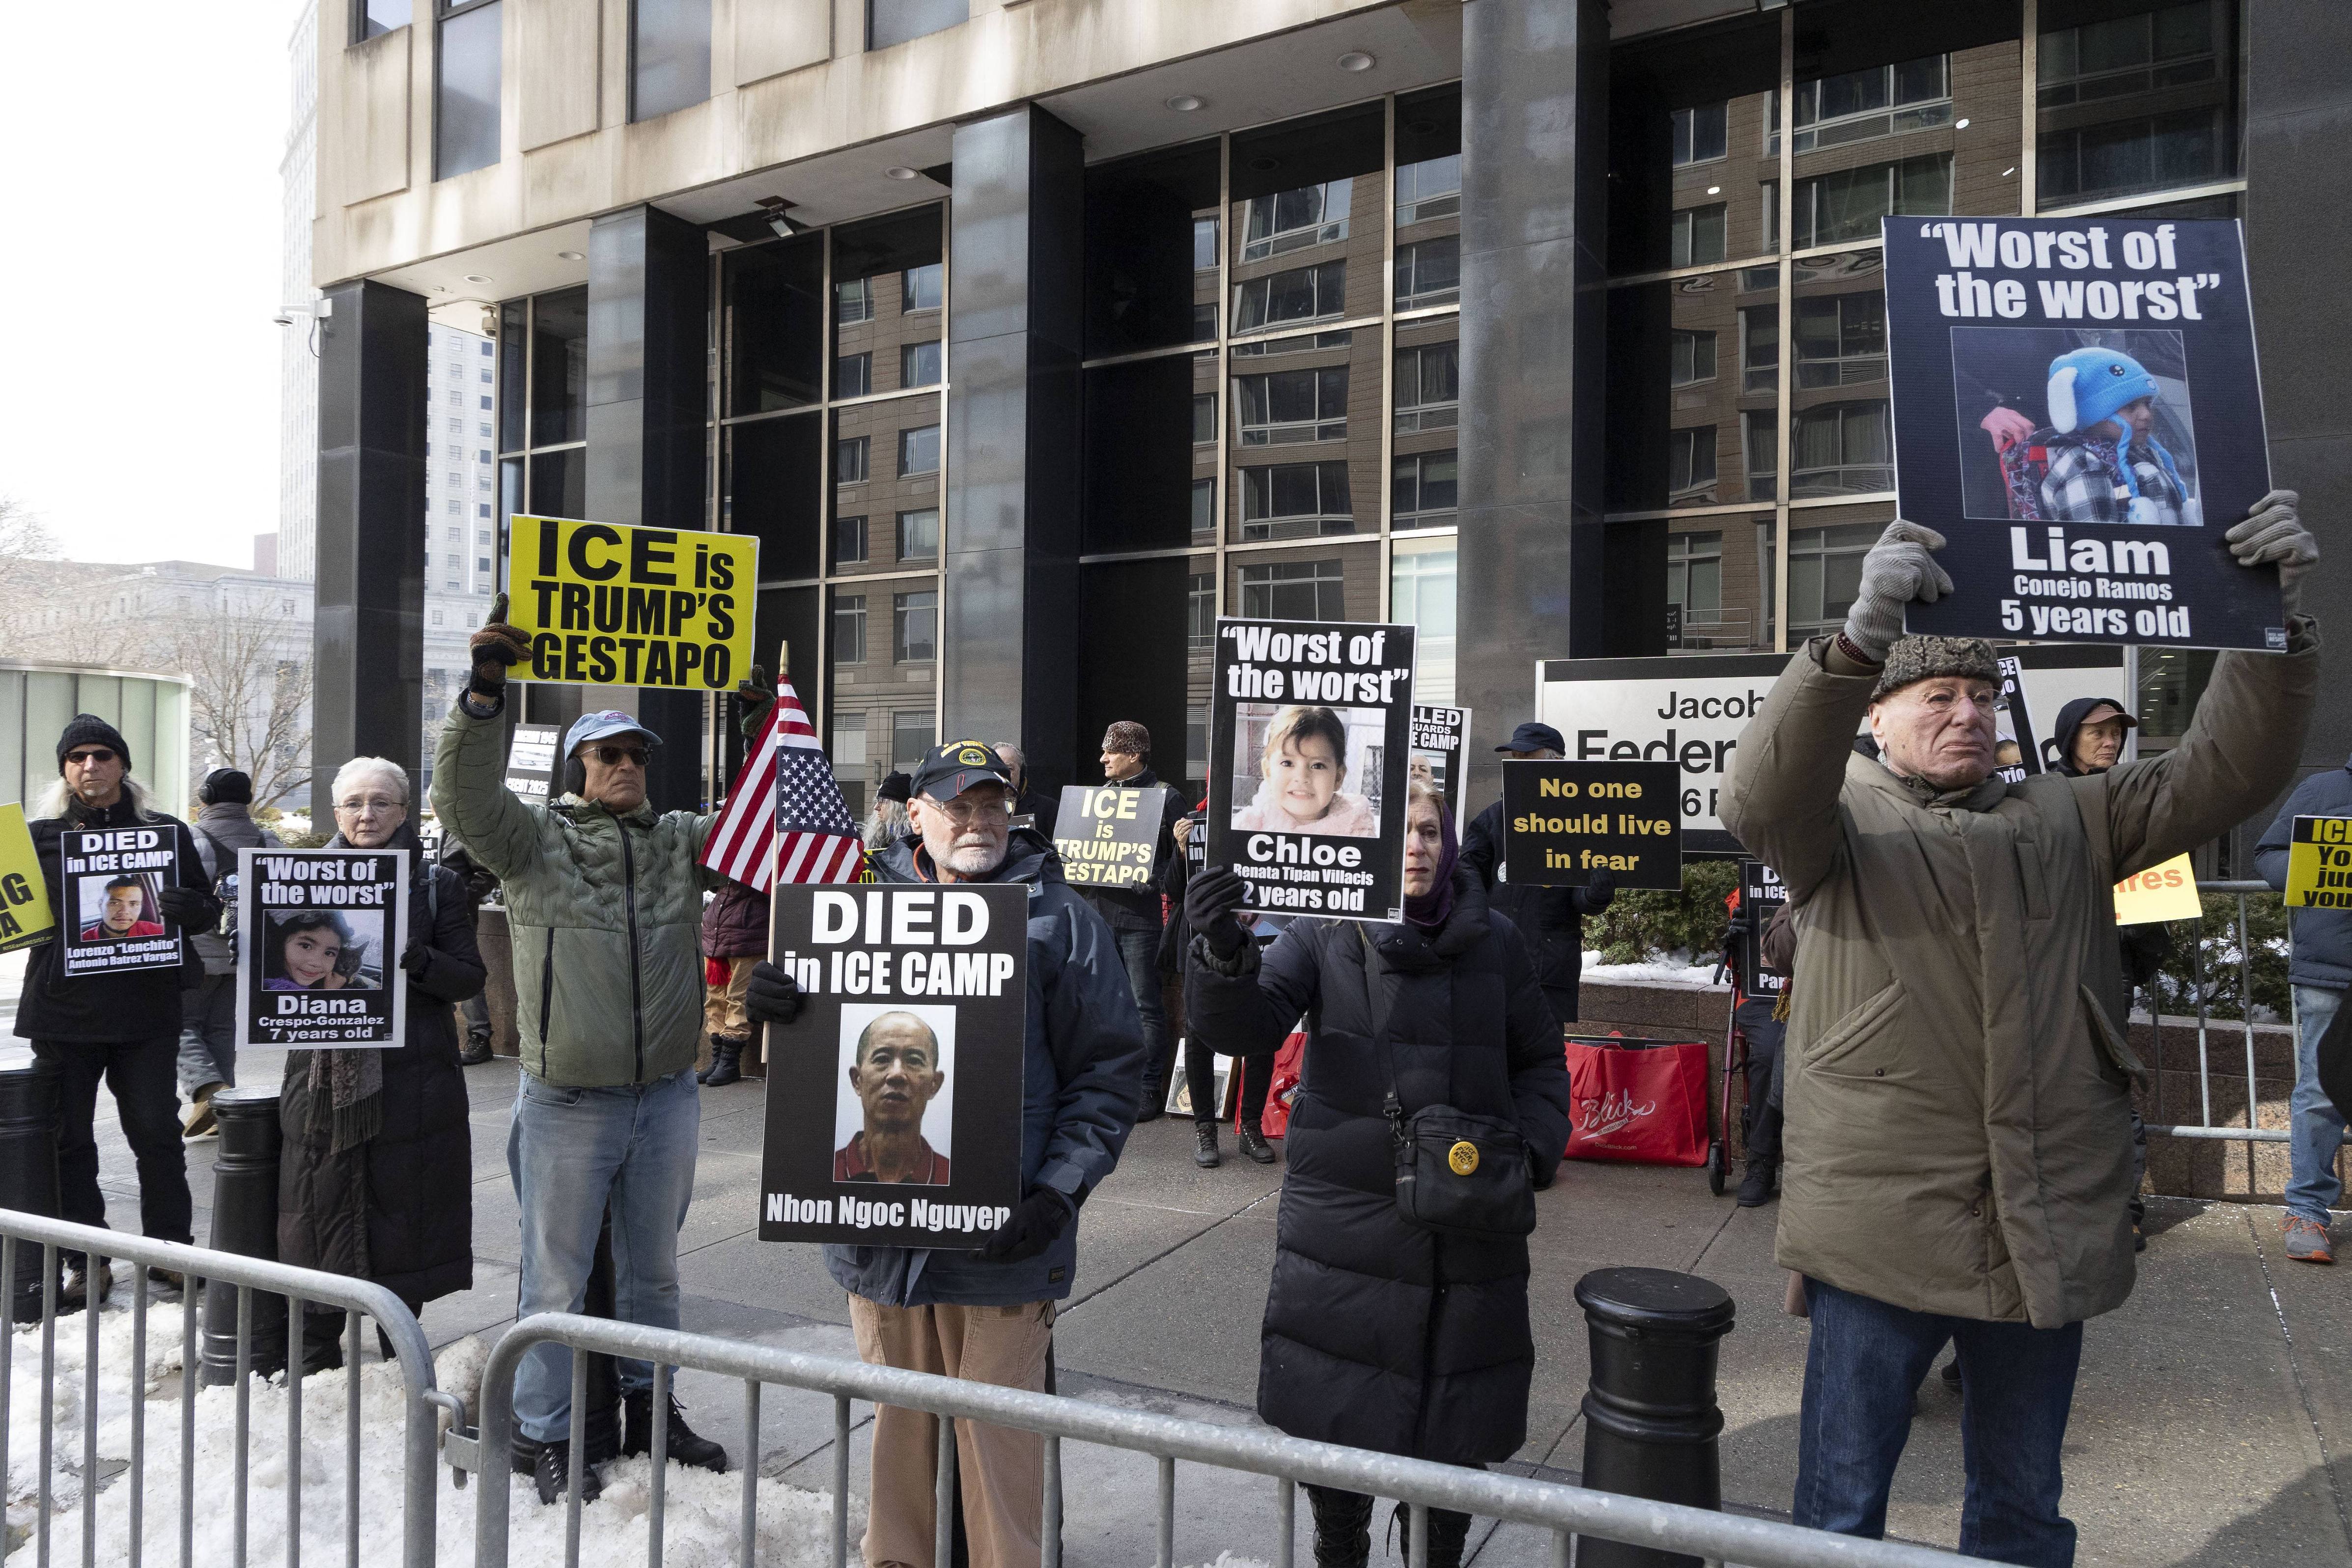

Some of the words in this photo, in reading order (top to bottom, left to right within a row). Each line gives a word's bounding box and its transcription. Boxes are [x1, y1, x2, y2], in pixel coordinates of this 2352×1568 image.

[1921, 223, 2112, 270] “Worst
[2122, 224, 2177, 270] of
[1935, 272, 2027, 318] the
[2038, 274, 2220, 320] worst”
[538, 520, 678, 586] ICE
[694, 544, 734, 590] is
[2011, 527, 2170, 575] Liam
[2014, 575, 2092, 598] Conejo
[2097, 577, 2172, 601] Ramos
[531, 580, 735, 640] TRUMP’S
[2001, 599, 2023, 631] 5
[2032, 605, 2128, 635] years
[2136, 605, 2190, 637] old
[1222, 626, 1342, 664] “Worst
[1349, 630, 1385, 666] of
[532, 632, 730, 688] GESTAPO
[1998, 660, 2016, 676] CE
[1228, 663, 1284, 699] the
[1292, 668, 1408, 703] worst”
[1657, 690, 1765, 719] Jacob
[1413, 707, 1460, 726] LED
[1421, 732, 1459, 750] CAMP
[1540, 778, 1578, 798] No
[1588, 781, 1642, 799] one
[1081, 789, 1140, 819] ICE
[1681, 788, 1701, 817] 6
[1095, 820, 1114, 839] is
[1513, 813, 1608, 834] should
[1619, 814, 1671, 836] live
[82, 831, 159, 852] DIED
[1055, 839, 1151, 864] TRUMP’S
[1189, 845, 1203, 860] in
[1247, 834, 1361, 867] Chloe
[67, 857, 85, 873] in
[89, 854, 118, 871] ICE
[122, 851, 174, 869] CAMP
[1546, 849, 1570, 868] in
[1581, 849, 1640, 871] fear
[2318, 846, 2352, 867] Yo
[256, 857, 346, 880] “Worst
[352, 858, 377, 881] of
[1062, 862, 1148, 884] ESTAPO
[1233, 864, 1279, 880] Renata
[1282, 867, 1319, 883] Tipan
[1322, 869, 1373, 886] Villacis
[261, 881, 304, 904] the
[310, 882, 394, 904] worst”
[1242, 881, 1254, 904] 2
[1259, 886, 1322, 908] years
[1327, 887, 1364, 911] old
[1749, 885, 1762, 898] in
[1765, 886, 1786, 899] ICE
[812, 891, 990, 945] DIED
[67, 945, 114, 958] Lorenzo
[116, 939, 178, 953] “Lenchito”
[69, 957, 108, 969] Antonio
[110, 954, 141, 965] Batrez
[142, 951, 178, 963] Vargas
[784, 951, 820, 993] in
[831, 951, 891, 994] ICE
[900, 952, 1014, 996] CAMP
[278, 995, 366, 1014] Diana
[258, 1016, 384, 1028] Crespo-Gonzalez
[270, 1029, 281, 1040] 7
[287, 1029, 338, 1042] years
[345, 1027, 372, 1038] old
[1576, 1088, 1635, 1131] Blick
[1595, 1142, 1637, 1150] DickBlick.com
[767, 1193, 833, 1224] Nhon
[839, 1196, 903, 1227] Ngoc
[911, 1199, 1010, 1232] Nguyen
